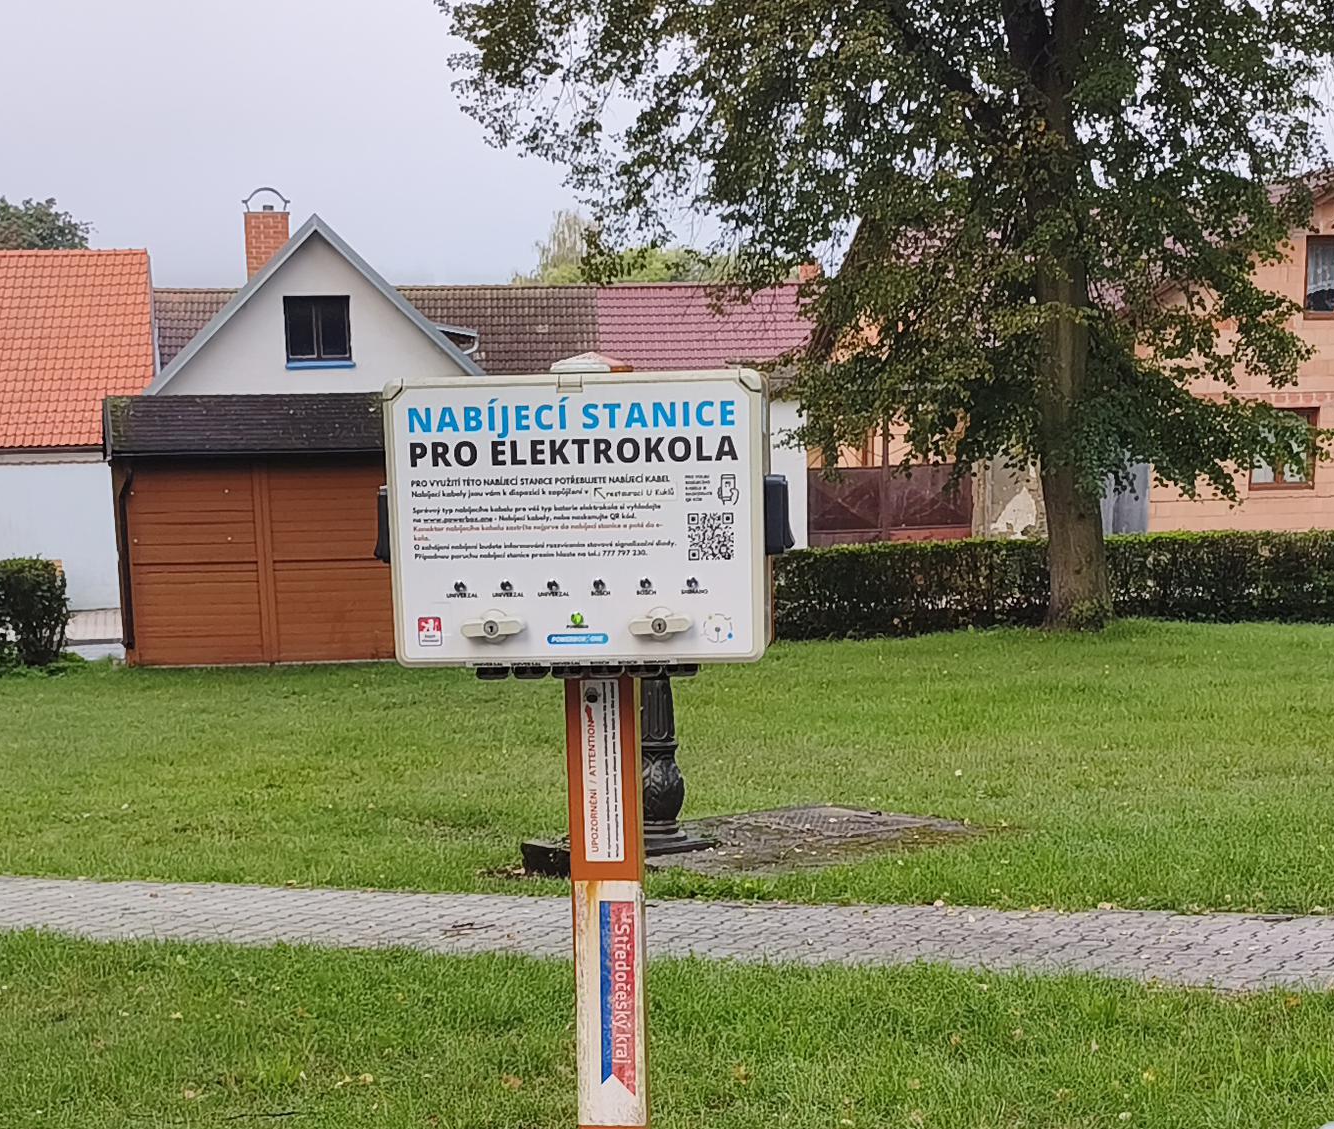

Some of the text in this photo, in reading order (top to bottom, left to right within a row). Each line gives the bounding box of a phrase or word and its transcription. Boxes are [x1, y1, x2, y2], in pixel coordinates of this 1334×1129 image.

[407, 397, 736, 438] NABÍJECÍ STANICE
[409, 436, 738, 468] PRO ELEKTROKOLA
[429, 477, 460, 487] VYUŽITÍ
[462, 477, 482, 486] TÉTO
[484, 476, 518, 486] NABÍJECÍ
[520, 478, 552, 486] STANICE
[555, 475, 606, 485] POTŘEBUJETE
[609, 474, 644, 484] NABÍJECÍ
[442, 490, 466, 498] kabely
[468, 490, 483, 498] jsou
[587, 720, 596, 776] ATTENTION
[588, 788, 599, 853] UPOZORNĚNÍ
[612, 923, 632, 1064] Středočeský kraj
